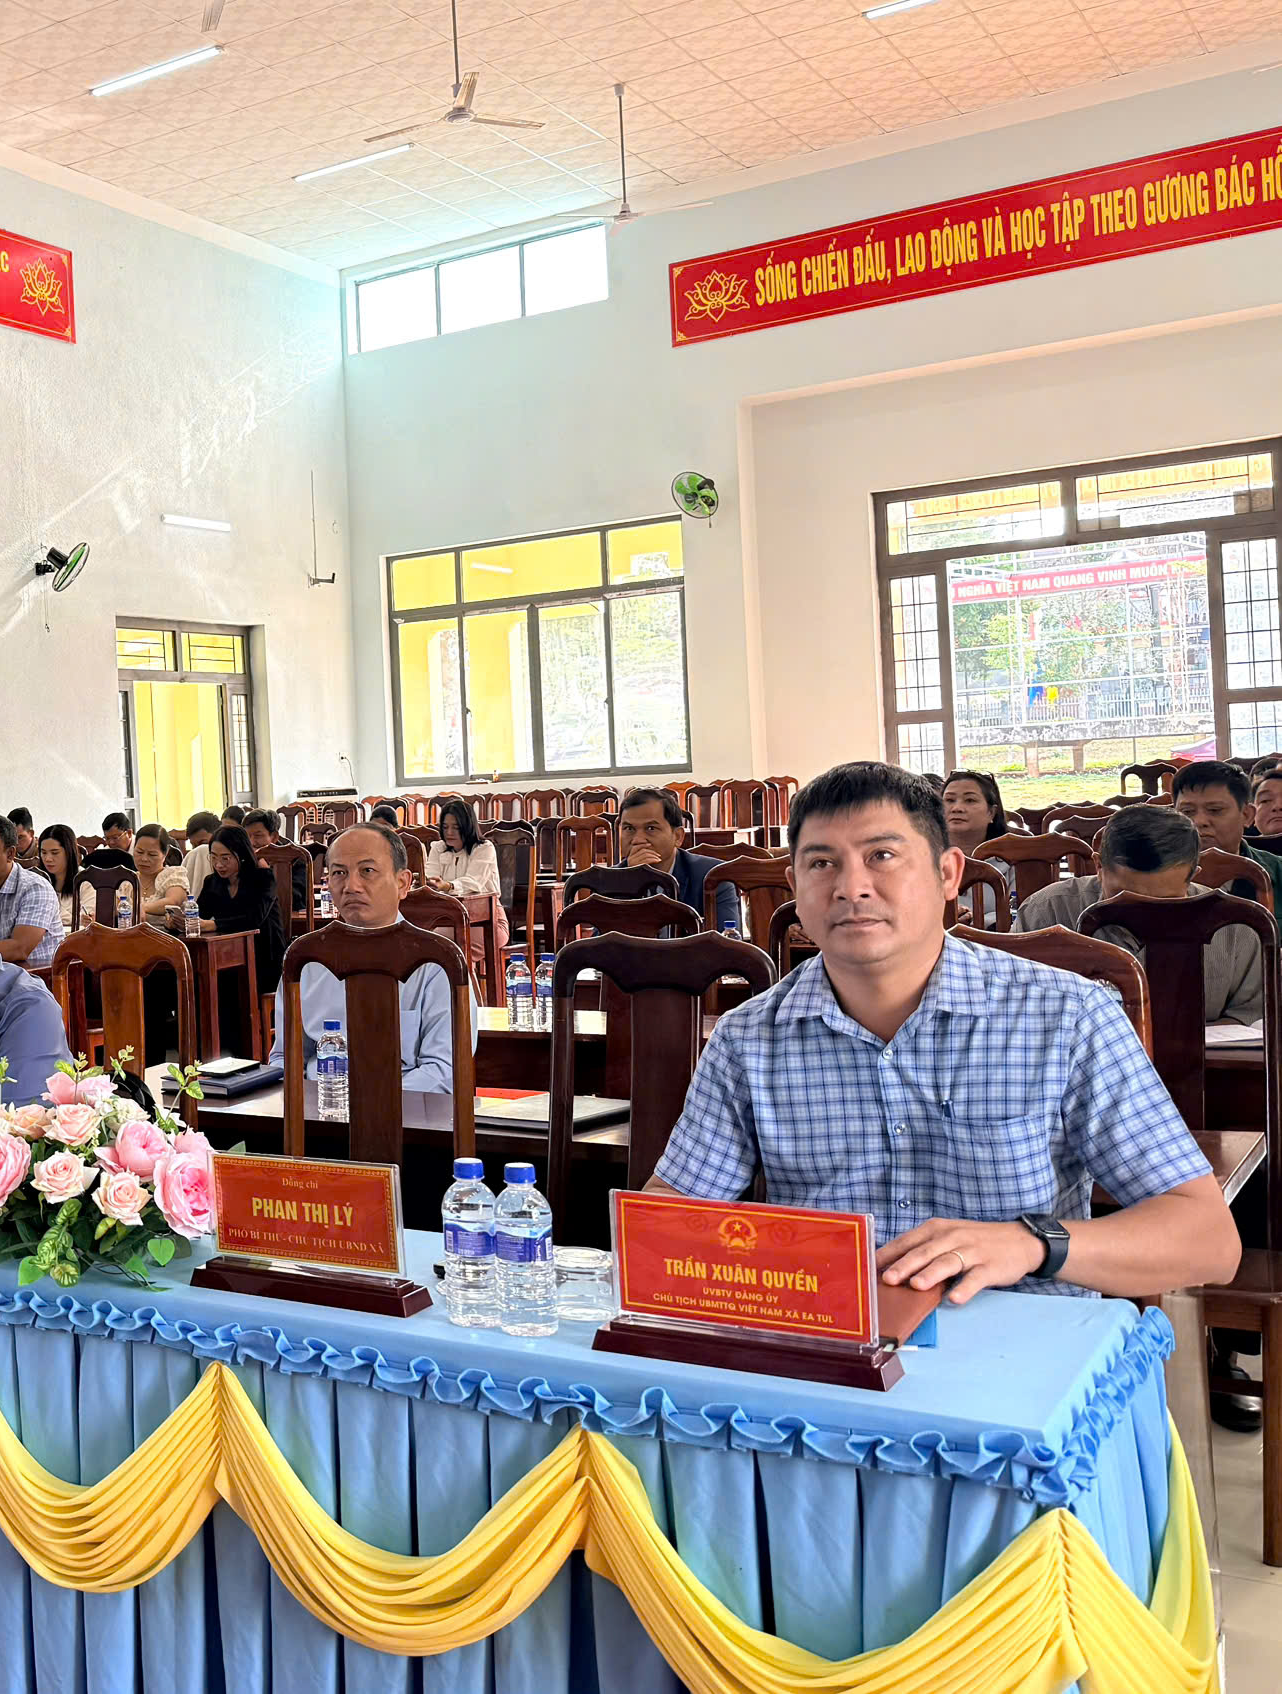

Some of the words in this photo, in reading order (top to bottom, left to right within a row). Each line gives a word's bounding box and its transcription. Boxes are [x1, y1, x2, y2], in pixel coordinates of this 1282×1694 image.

[754, 251, 797, 306] SỐNG
[801, 238, 849, 297] CHIẾN
[853, 228, 891, 285] ĐẤU,
[895, 231, 926, 277] LAO
[930, 217, 977, 276] ĐỘNG
[981, 206, 1006, 258] VÀ
[1009, 205, 1046, 260] HỌC
[1050, 191, 1085, 251] TẬP
[1090, 186, 1137, 237] THEO
[1143, 170, 1210, 226] GƯƠNG
[1214, 154, 1255, 212] BÁC
[1022, 577, 1050, 591] NAM
[1053, 573, 1095, 588] QUANG
[1097, 568, 1126, 583] VINH
[252, 1197, 298, 1221] PHAN
[302, 1201, 329, 1229] THỊ
[333, 1202, 354, 1227] LÝ
[664, 1256, 707, 1279] TRẦN
[711, 1263, 757, 1285] XUÂN
[653, 1292, 673, 1303] CHỦ
[675, 1295, 697, 1306] TỊCH
[699, 1298, 736, 1311] UBMTTQ
[738, 1303, 759, 1315] VIỆT
[760, 1306, 782, 1317] NAM
[785, 1308, 799, 1320] XÃ
[802, 1311, 815, 1322] EA
[816, 1314, 834, 1324] TUL
[702, 1286, 732, 1298] UVBTV
[735, 1289, 764, 1302] ĐẢNG
